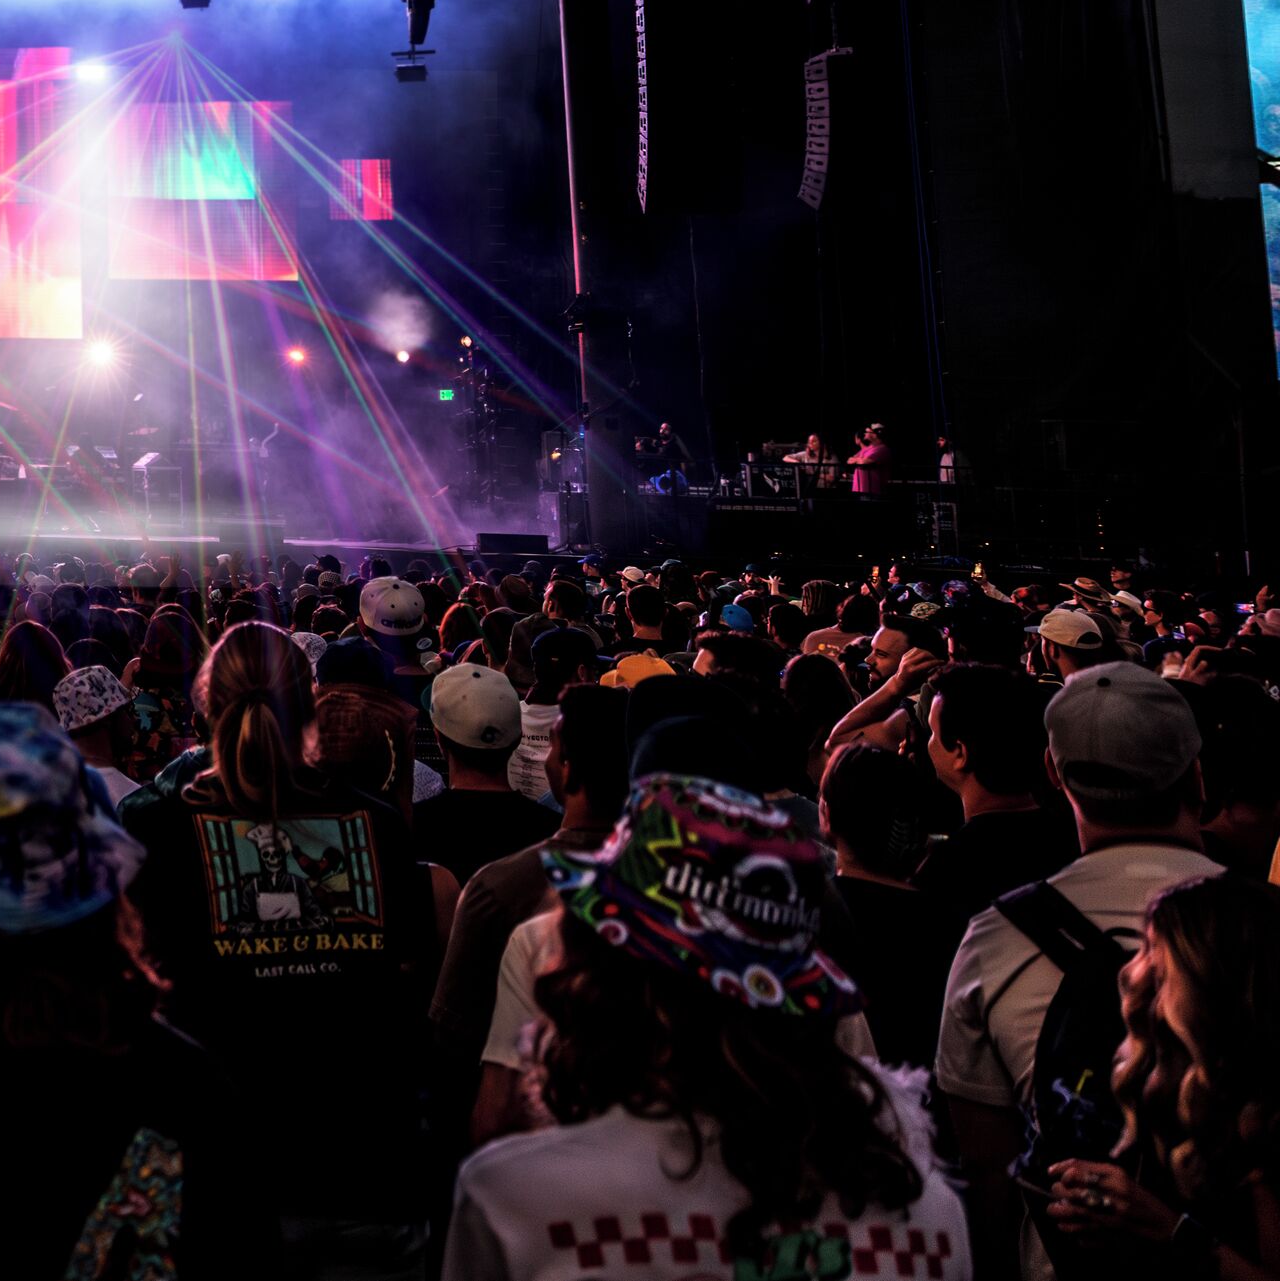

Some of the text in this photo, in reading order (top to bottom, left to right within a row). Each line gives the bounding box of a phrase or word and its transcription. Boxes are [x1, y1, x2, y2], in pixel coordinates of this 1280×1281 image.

[213, 932, 385, 958] WAKE & BAKE
[254, 961, 342, 978] LAST CALL CO.
